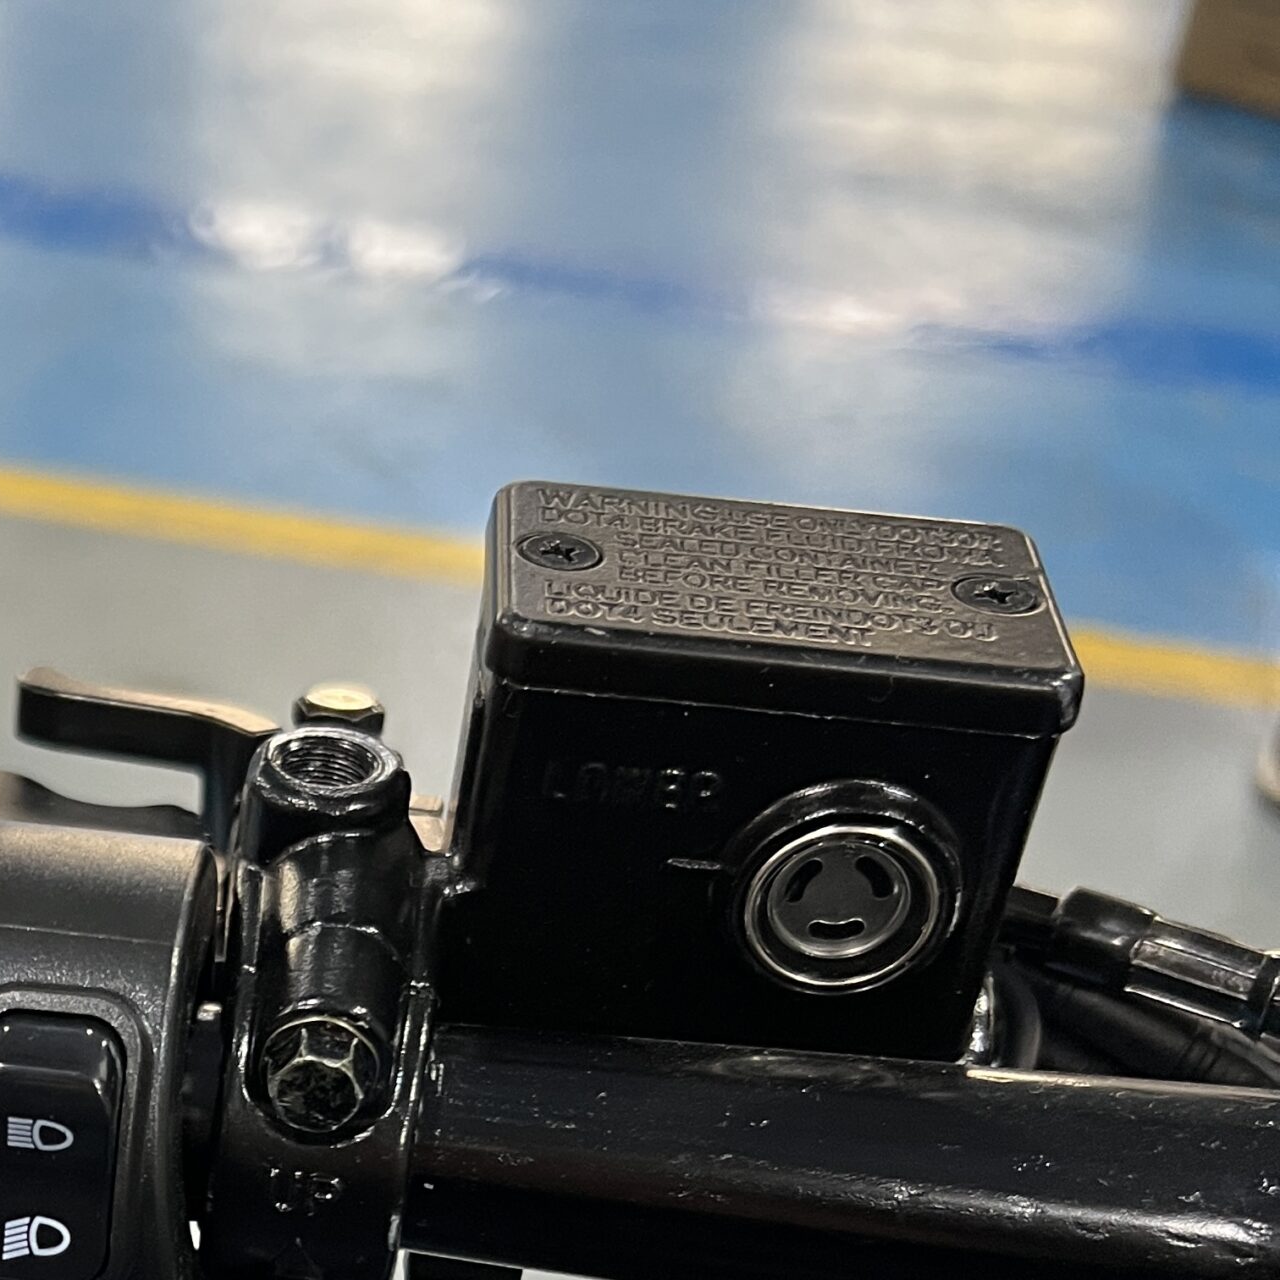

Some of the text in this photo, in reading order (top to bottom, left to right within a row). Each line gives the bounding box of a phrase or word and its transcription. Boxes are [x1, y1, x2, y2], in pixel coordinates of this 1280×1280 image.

[637, 514, 758, 541] BRAKE
[614, 531, 743, 558] SEALED
[619, 551, 747, 575] CLEAN
[751, 561, 866, 590] FILLER
[619, 569, 757, 594] BEFORE
[544, 578, 681, 609] LIQUIDE
[687, 594, 741, 616] DE
[651, 609, 877, 647] SEULEMENT
